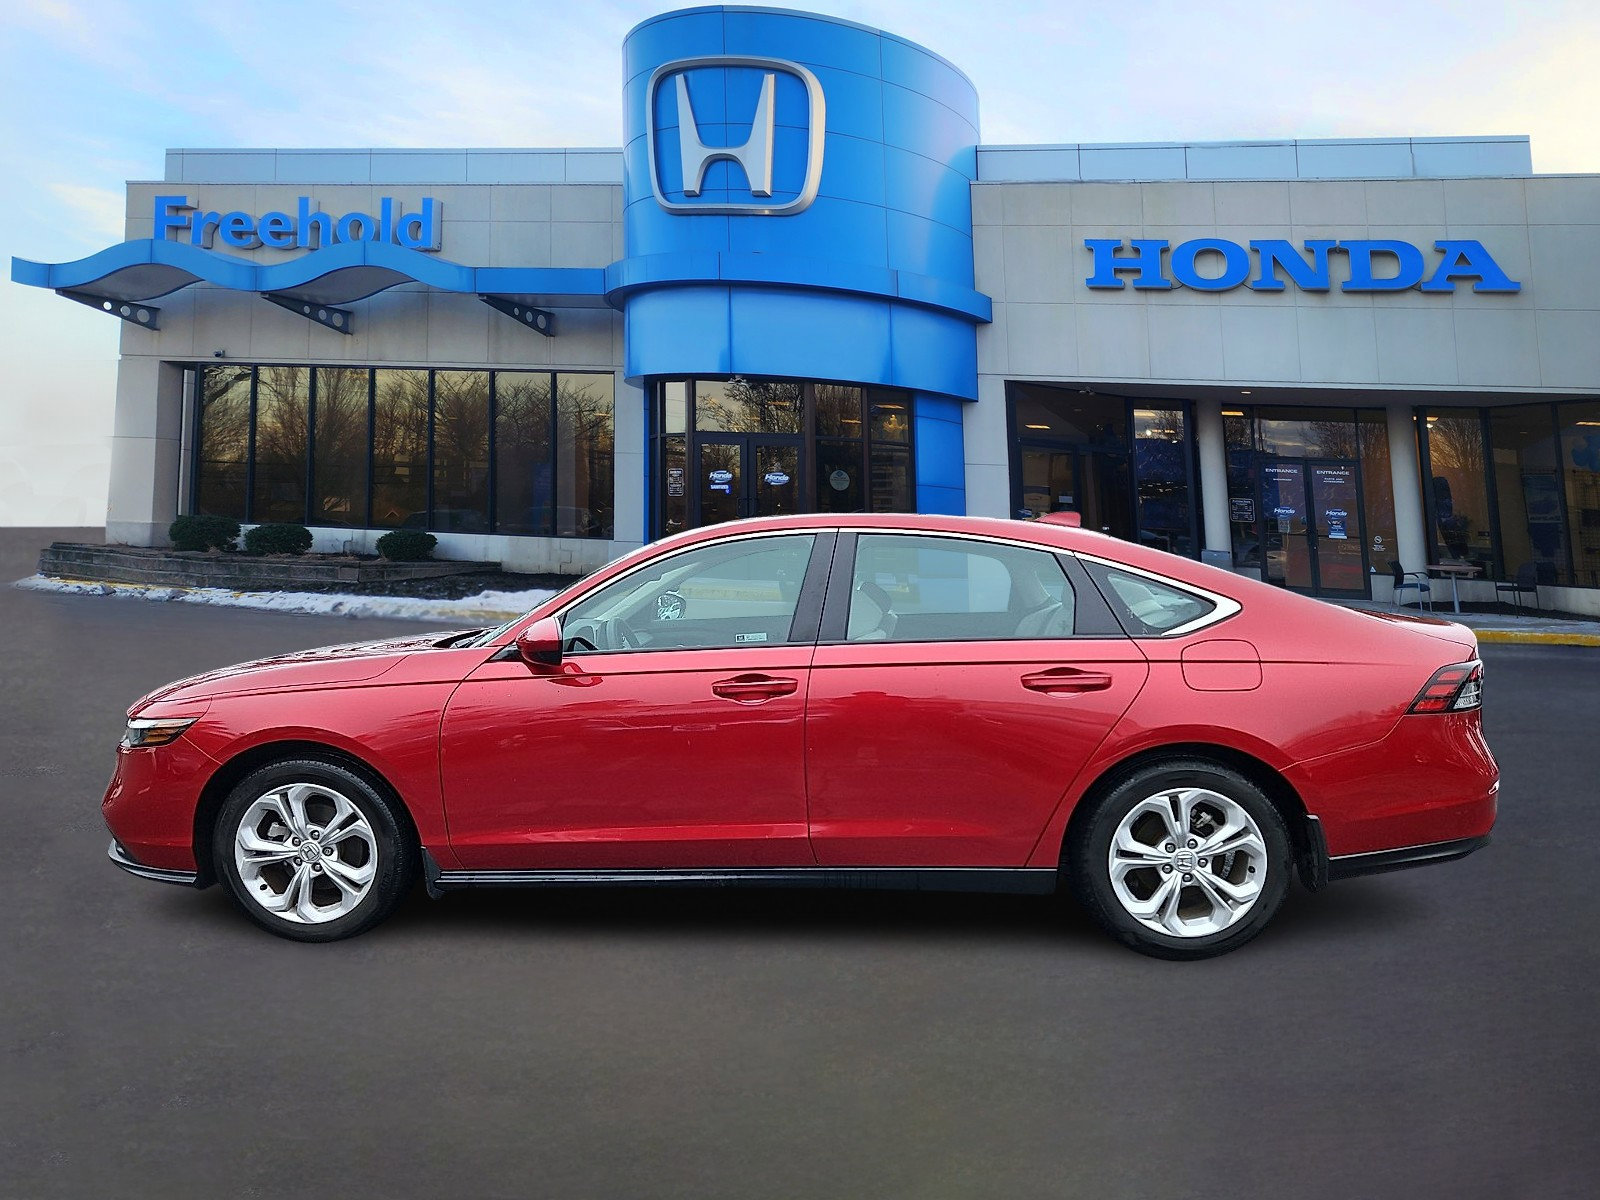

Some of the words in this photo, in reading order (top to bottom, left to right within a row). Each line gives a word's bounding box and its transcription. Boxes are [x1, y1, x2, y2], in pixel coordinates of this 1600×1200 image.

[153, 195, 442, 250] Freehold
[1084, 238, 1521, 292] HONDA
[709, 471, 733, 480] Honda
[764, 473, 790, 481] Honda
